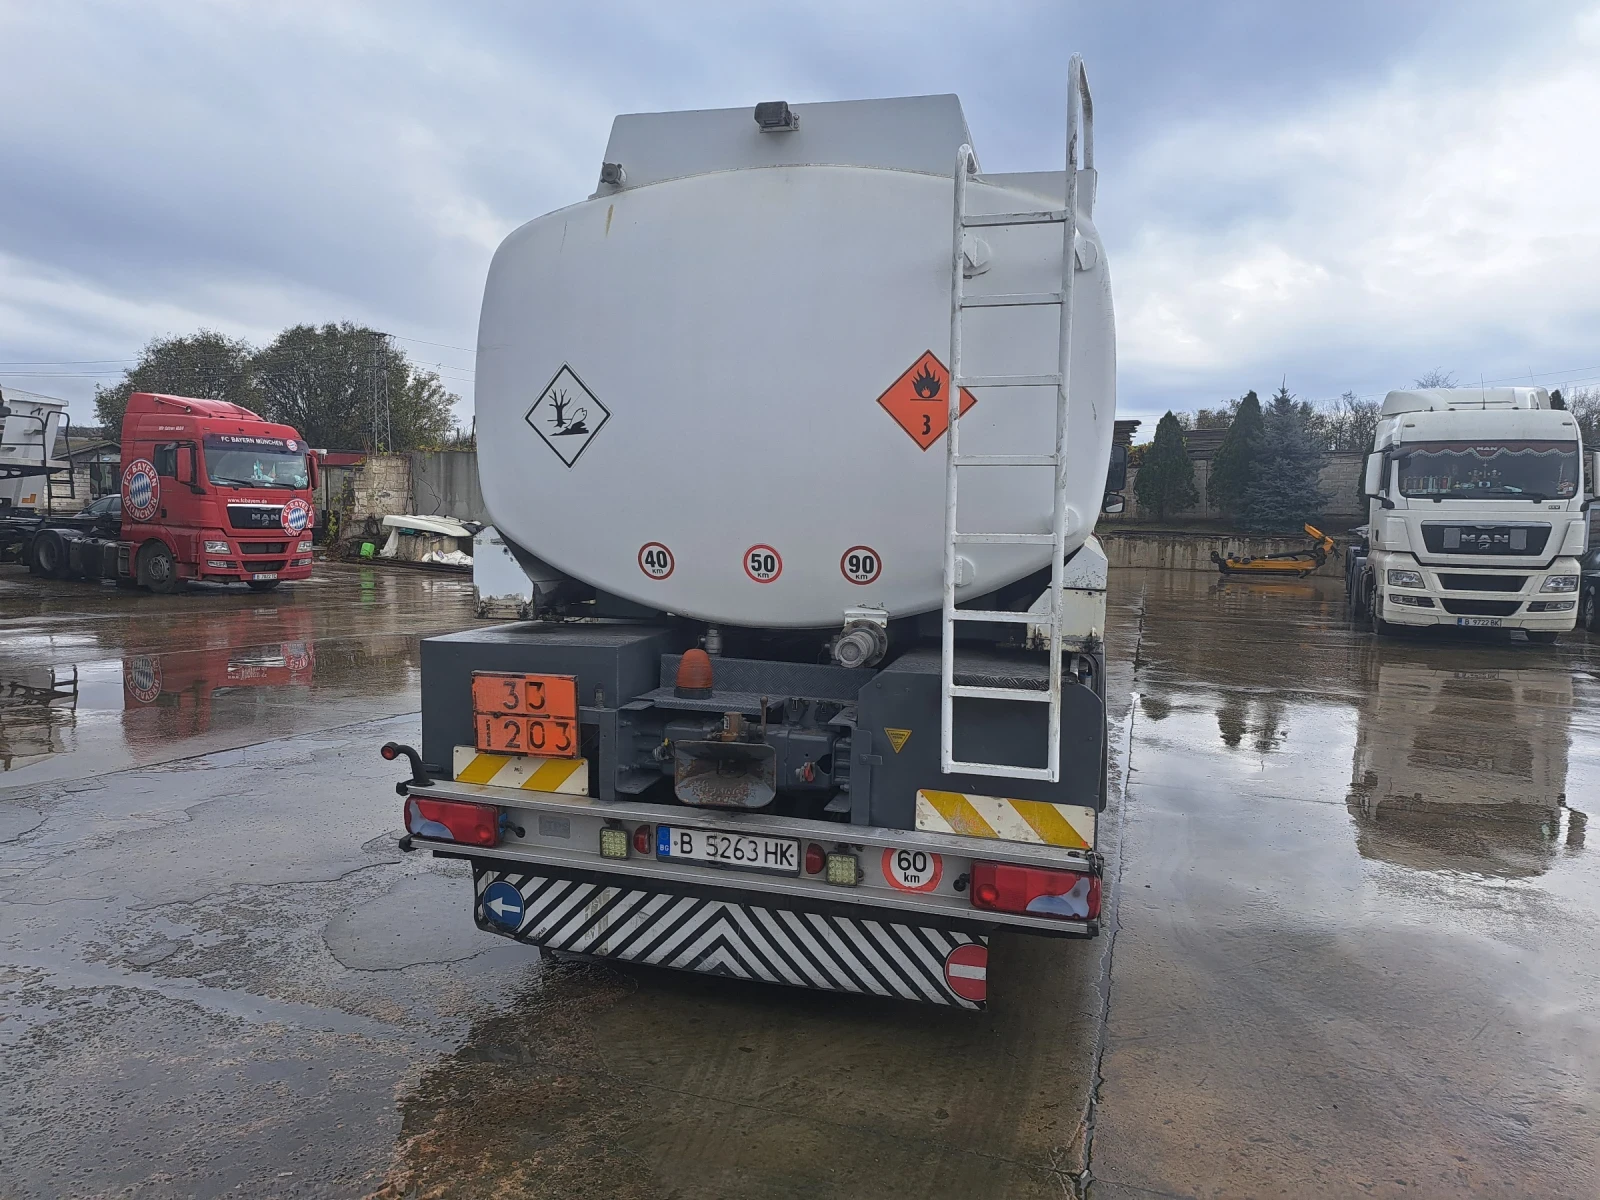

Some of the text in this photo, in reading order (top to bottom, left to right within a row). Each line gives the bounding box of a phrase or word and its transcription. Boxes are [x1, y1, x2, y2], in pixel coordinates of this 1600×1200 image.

[922, 414, 931, 435] 3
[255, 438, 284, 446] MÜNCHEN
[124, 462, 158, 487] FC BAYERN
[251, 513, 280, 521] MAN
[283, 506, 290, 517] FC
[1461, 534, 1509, 543] MAN
[644, 550, 668, 569] 40
[750, 553, 775, 573] 50
[848, 554, 875, 574] 90
[502, 680, 546, 710] 33
[485, 719, 571, 752] 1203
[680, 832, 793, 866] B 5263 HK
[897, 849, 927, 873] 60
[904, 872, 920, 884] km
